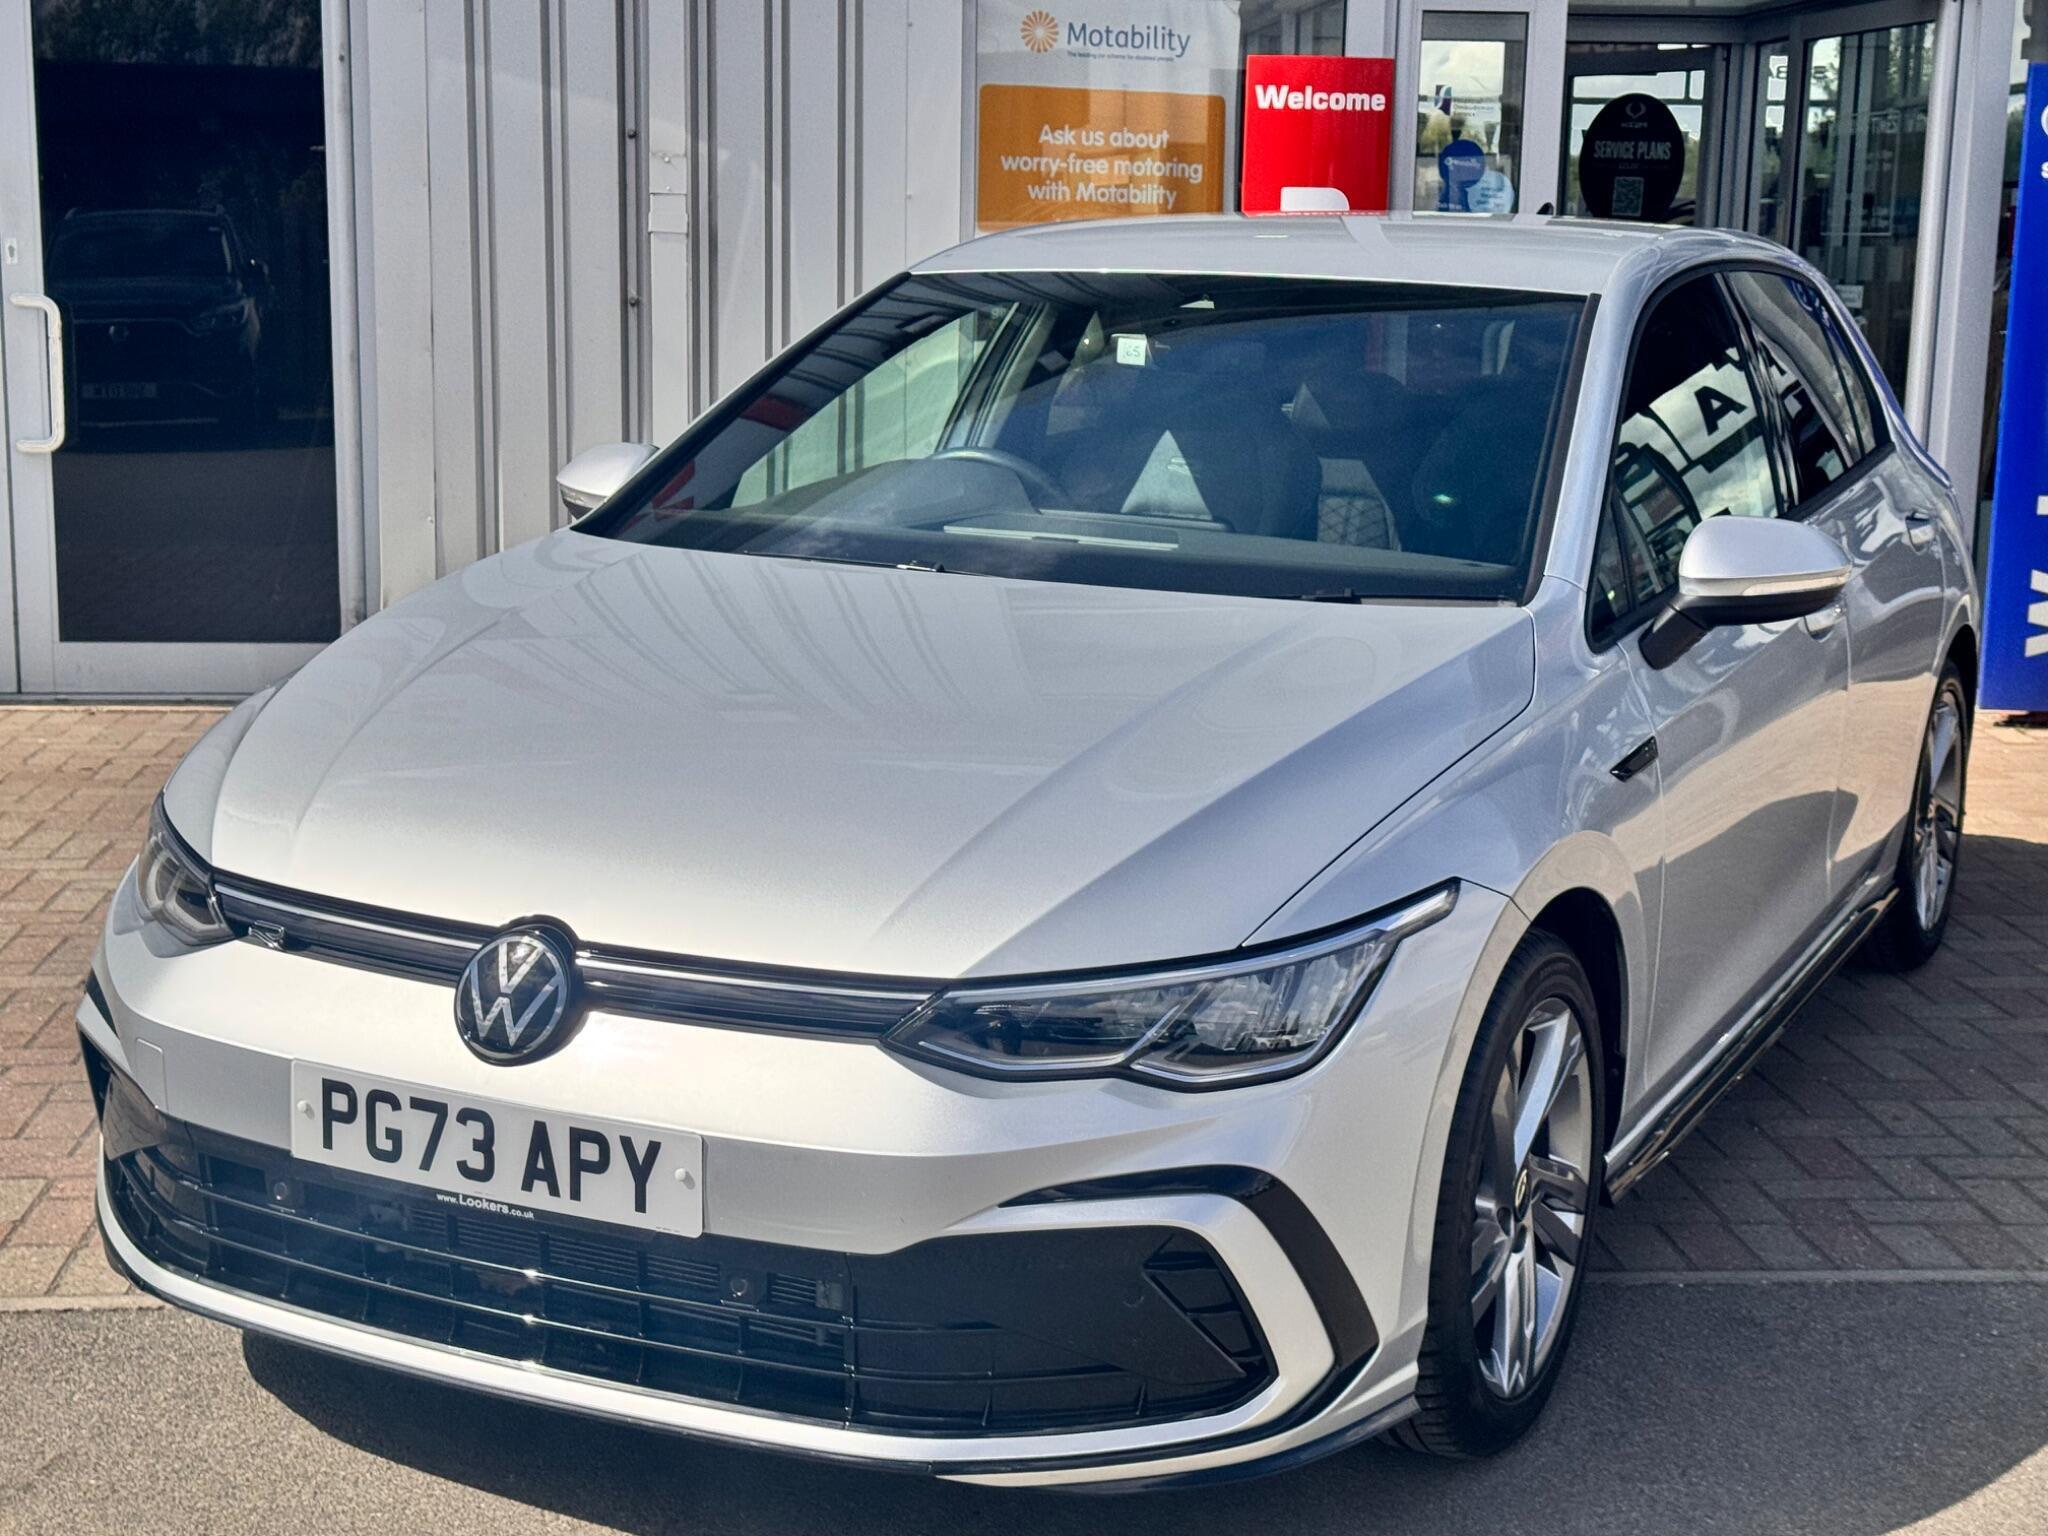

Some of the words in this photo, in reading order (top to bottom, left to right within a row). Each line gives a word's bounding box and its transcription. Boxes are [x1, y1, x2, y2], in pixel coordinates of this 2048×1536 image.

[1067, 22, 1191, 58] Motability
[1254, 84, 1386, 111] Welcome
[1039, 125, 1076, 145] Ask
[1081, 130, 1105, 145] us
[1109, 128, 1169, 149] about
[1593, 140, 1635, 159] SERVICE
[1636, 140, 1672, 160] PLANS
[1001, 153, 1109, 176] worry-free
[1113, 157, 1203, 184] motoring
[1028, 180, 1070, 201] with
[1076, 182, 1177, 210] Motability
[321, 1077, 496, 1184] PG73
[520, 1120, 662, 1214] APY
[436, 1193, 535, 1218] www.Lookers.co.uk
